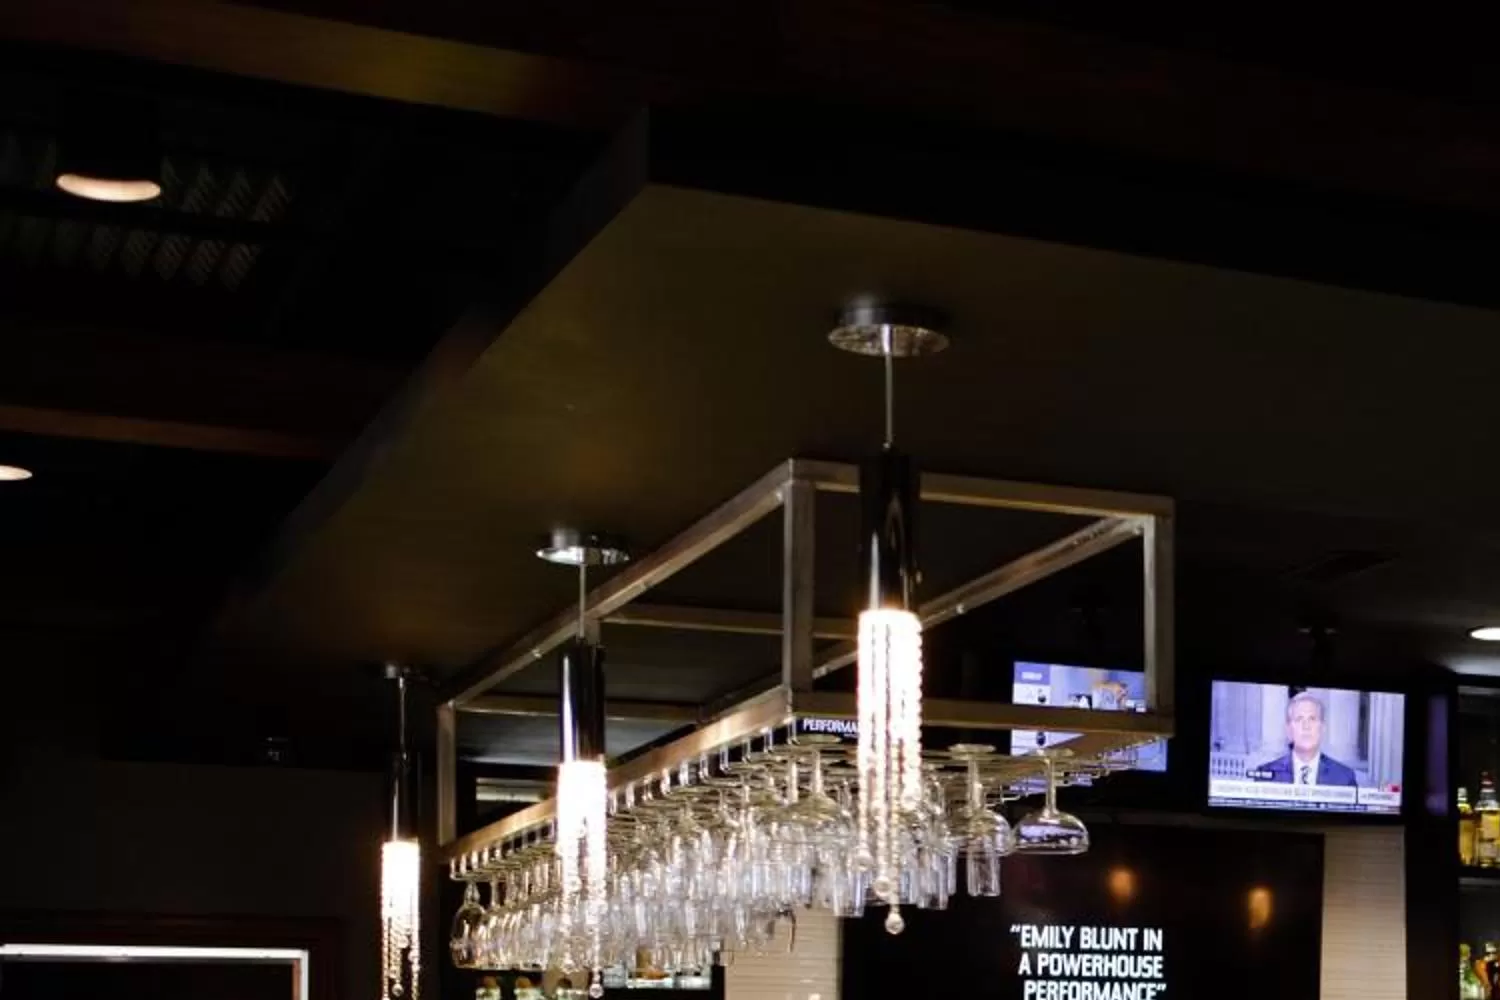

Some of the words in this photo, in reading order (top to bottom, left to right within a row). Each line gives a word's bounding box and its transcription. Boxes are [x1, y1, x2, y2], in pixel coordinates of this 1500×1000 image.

[1010, 924, 1074, 949] “EMILY
[1080, 926, 1138, 950] BLUNT
[1143, 928, 1163, 951] IN
[1018, 951, 1031, 975] A
[1037, 953, 1163, 978] POWERHOUSE
